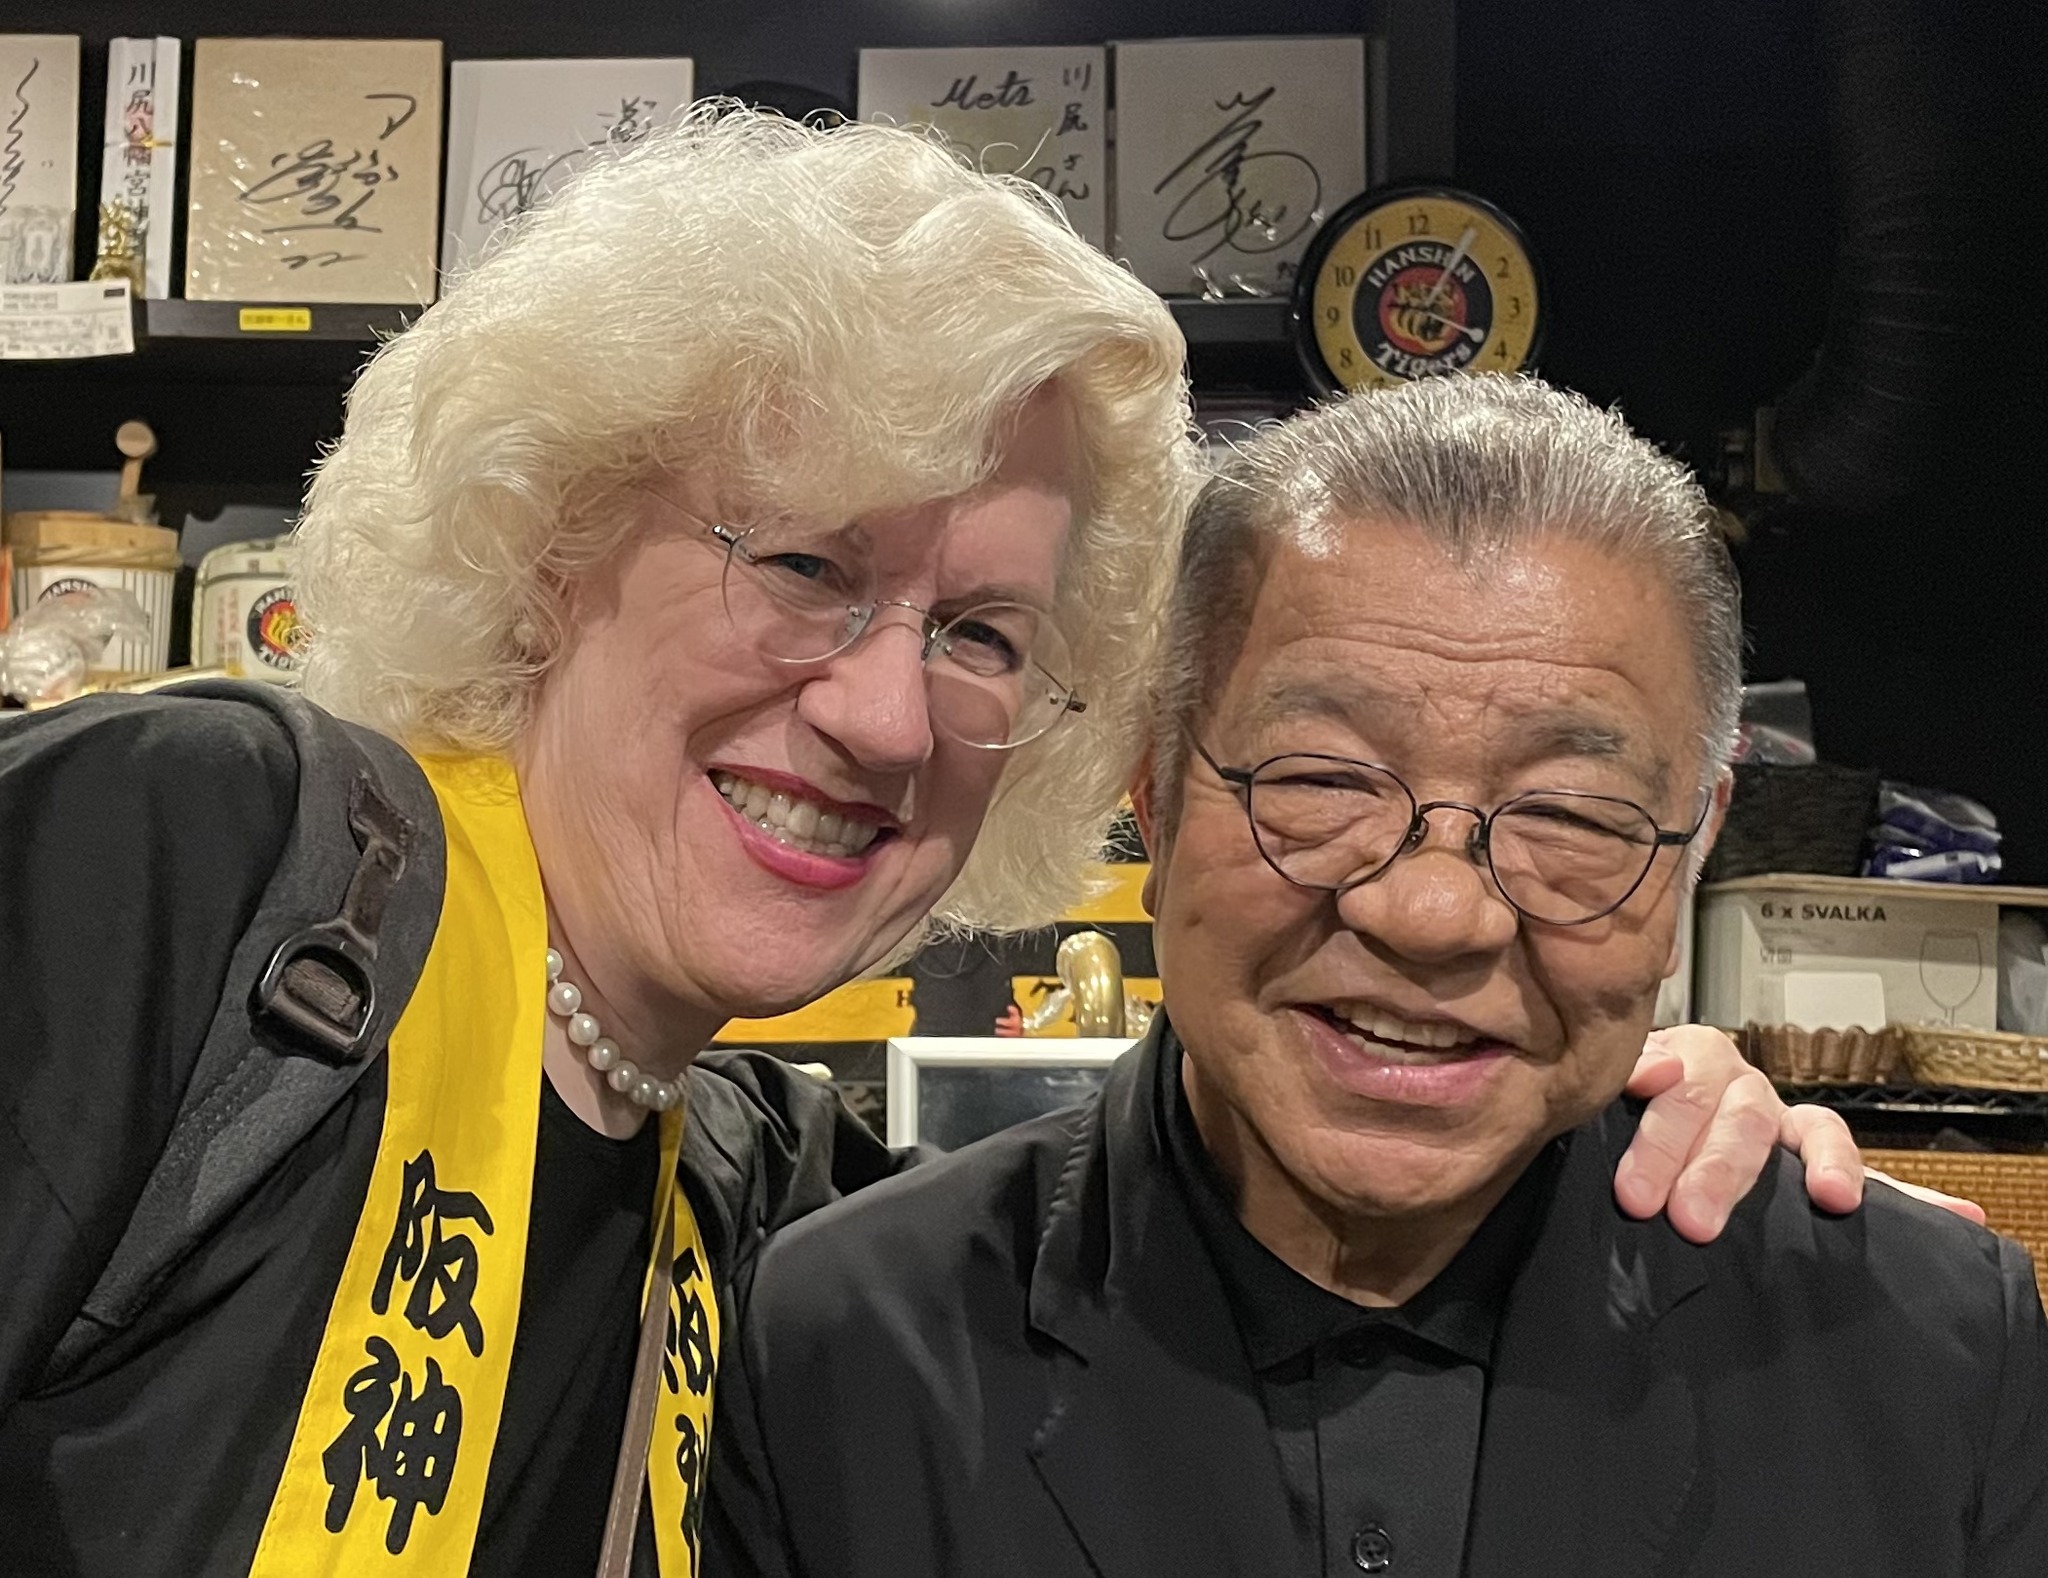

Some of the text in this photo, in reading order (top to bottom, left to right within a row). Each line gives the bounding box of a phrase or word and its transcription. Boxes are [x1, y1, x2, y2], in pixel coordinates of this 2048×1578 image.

[1408, 214, 1429, 235] 12
[1365, 227, 1381, 249] 11
[1335, 266, 1355, 287] 10
[1497, 257, 1508, 278] 2
[1327, 307, 1340, 326] 9
[1509, 298, 1520, 318] 3
[1340, 349, 1353, 368] 8
[1493, 341, 1508, 359] 4
[1761, 902, 1887, 921] 6 x SVALKA
[323, 1149, 494, 1555] 阪神
